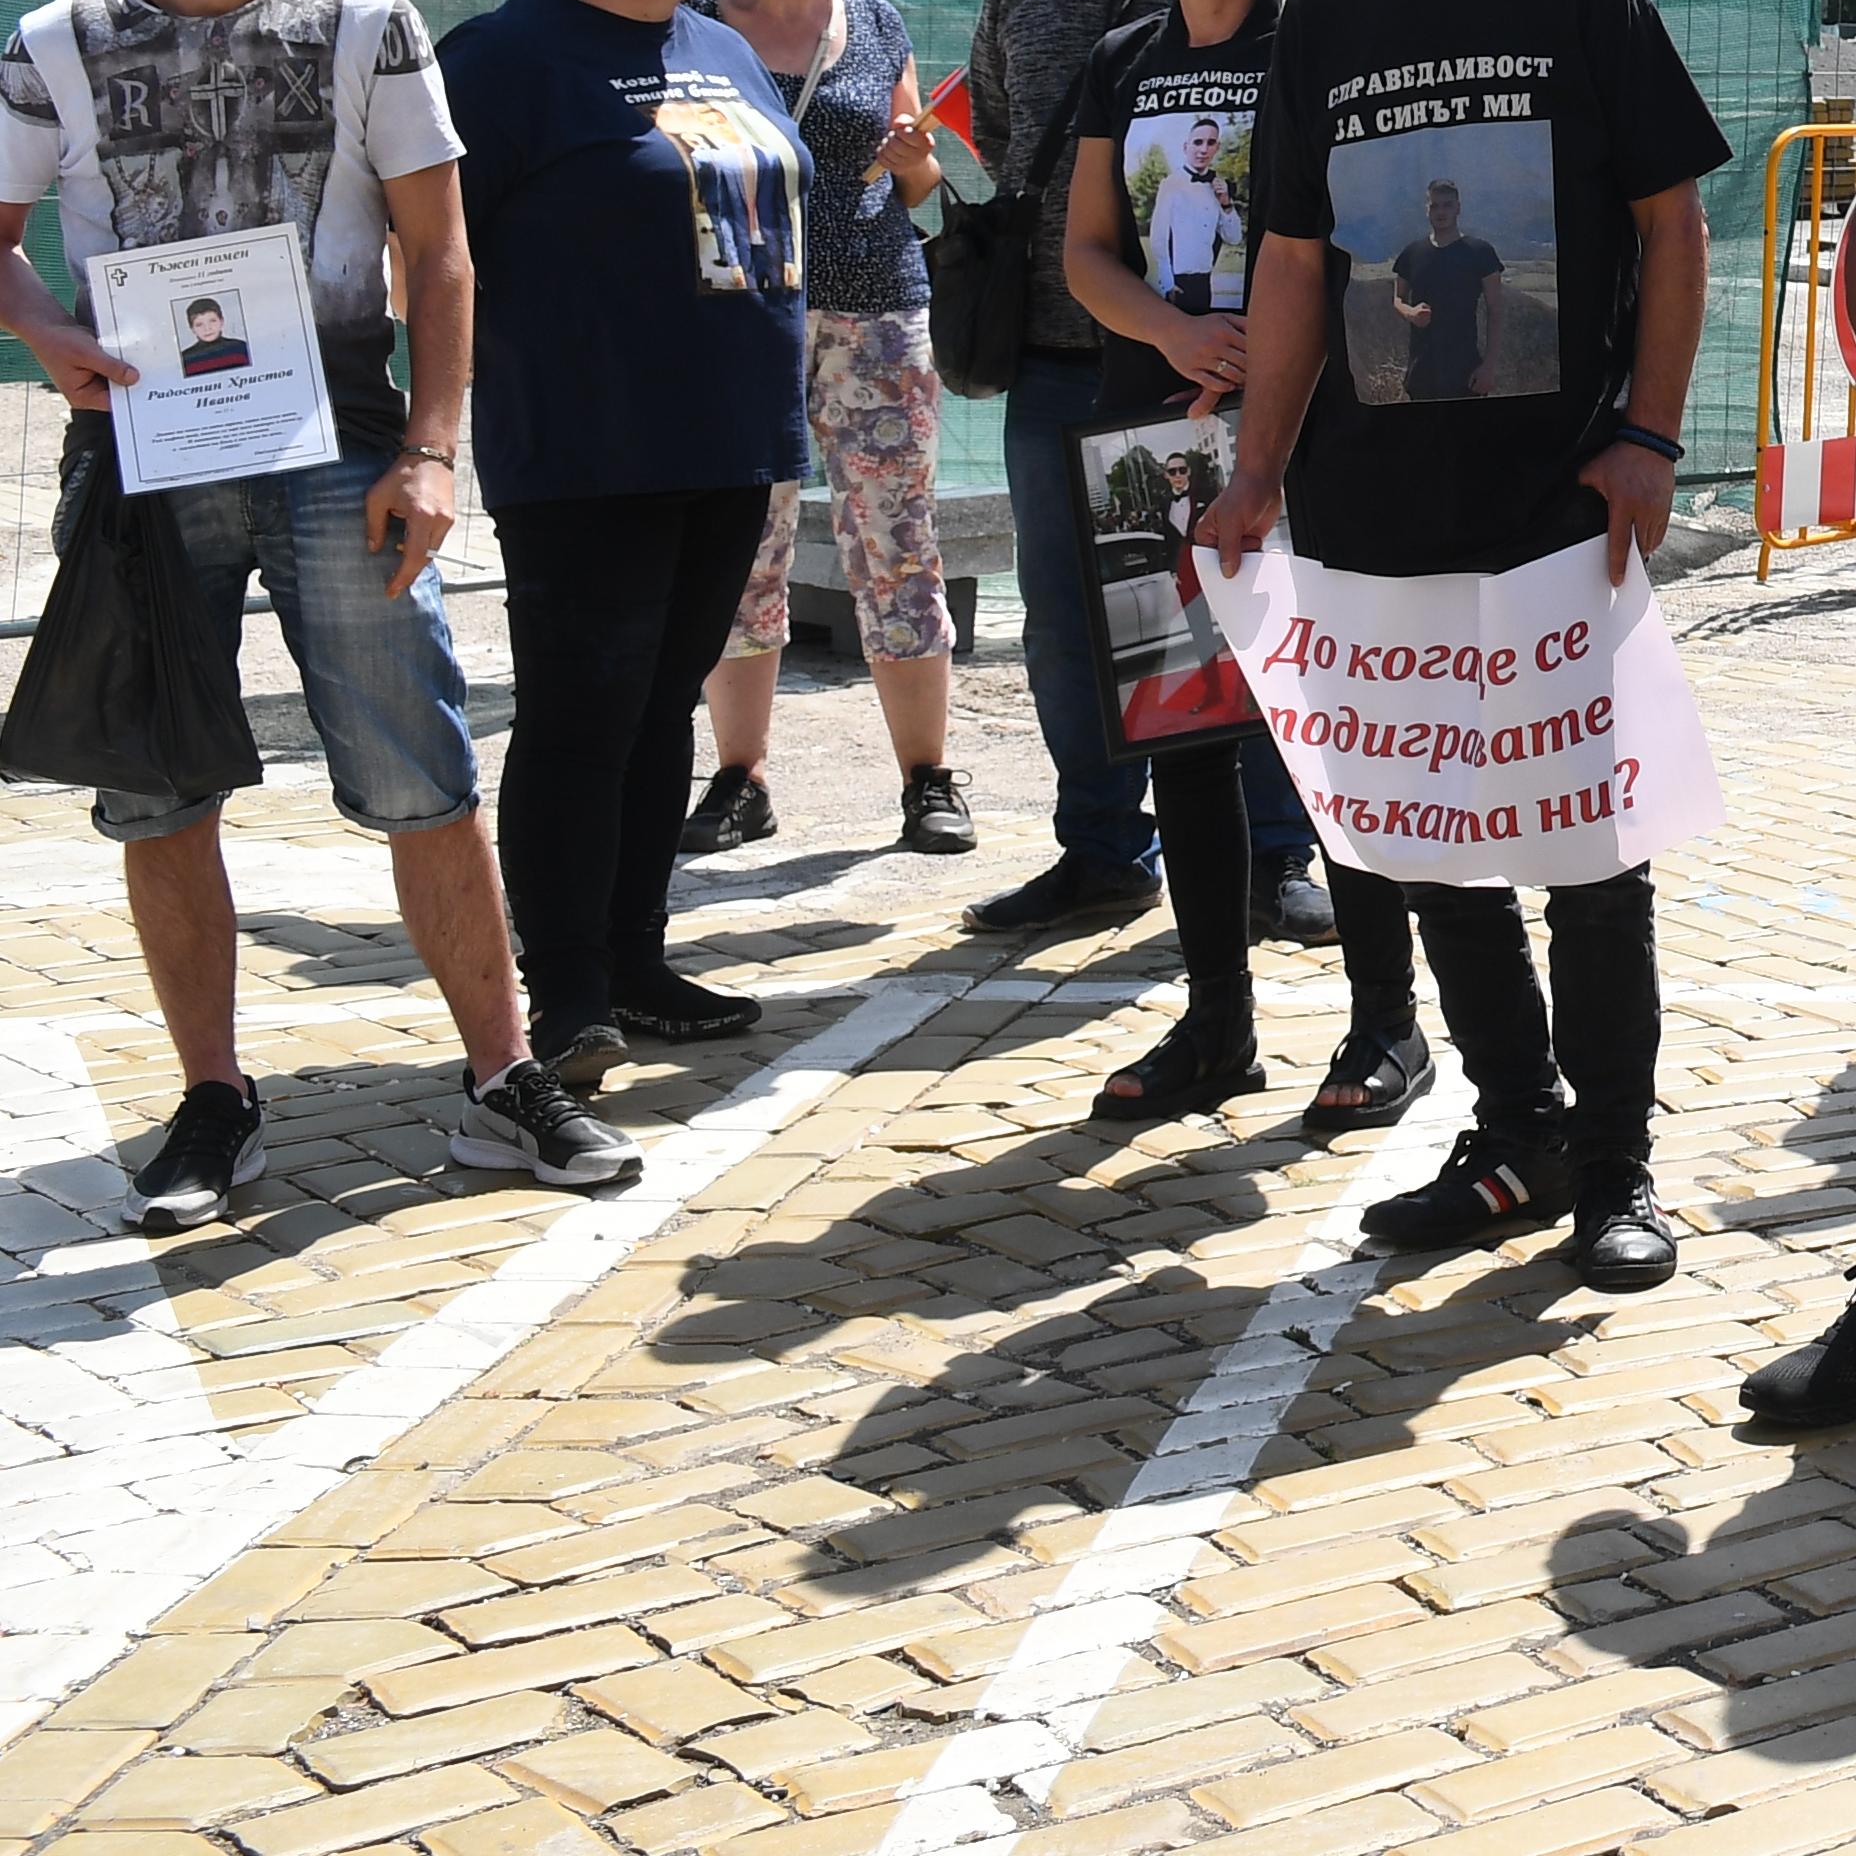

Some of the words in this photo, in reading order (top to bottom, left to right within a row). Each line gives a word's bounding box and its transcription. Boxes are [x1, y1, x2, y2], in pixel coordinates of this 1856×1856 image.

[1133, 92, 1160, 113] ЗА
[1163, 88, 1258, 109] СТЕФЧО
[1138, 71, 1265, 92] СПРАВЕДЛИВОСТ
[1327, 55, 1553, 110] СПРАВЕДЛИВОСТ
[1376, 97, 1469, 137] СИНЪТ
[1483, 93, 1531, 118] МИ
[148, 259, 199, 274] Тъжен
[148, 380, 222, 401] Радостин
[228, 368, 293, 388] Христов
[196, 393, 251, 409] Иванов
[1262, 616, 1337, 676] До
[1348, 643, 1481, 683] кога
[1535, 619, 1589, 672] се
[1268, 694, 1614, 773] подигравате
[1312, 789, 1521, 843] мъката
[1537, 758, 1640, 833] ни?
